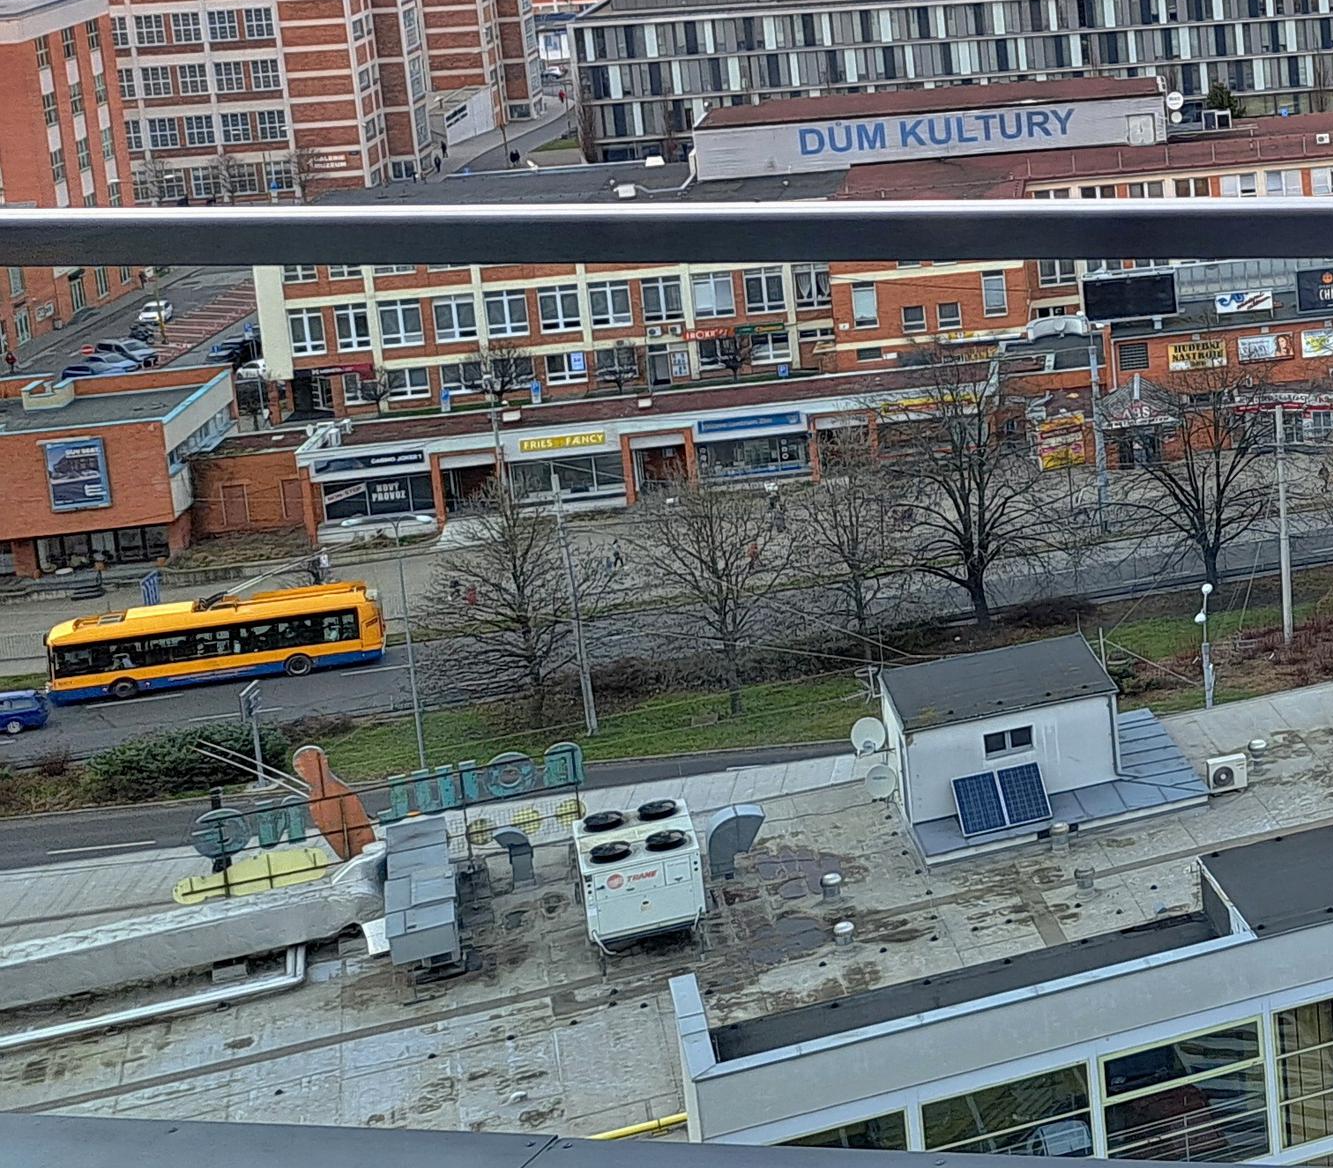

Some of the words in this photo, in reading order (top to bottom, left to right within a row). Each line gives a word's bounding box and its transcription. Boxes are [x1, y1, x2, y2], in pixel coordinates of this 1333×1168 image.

[799, 121, 887, 156] DŮM
[899, 108, 1076, 147] KULTURY
[523, 438, 553, 450] FRIES
[371, 490, 407, 503] PROVOZ
